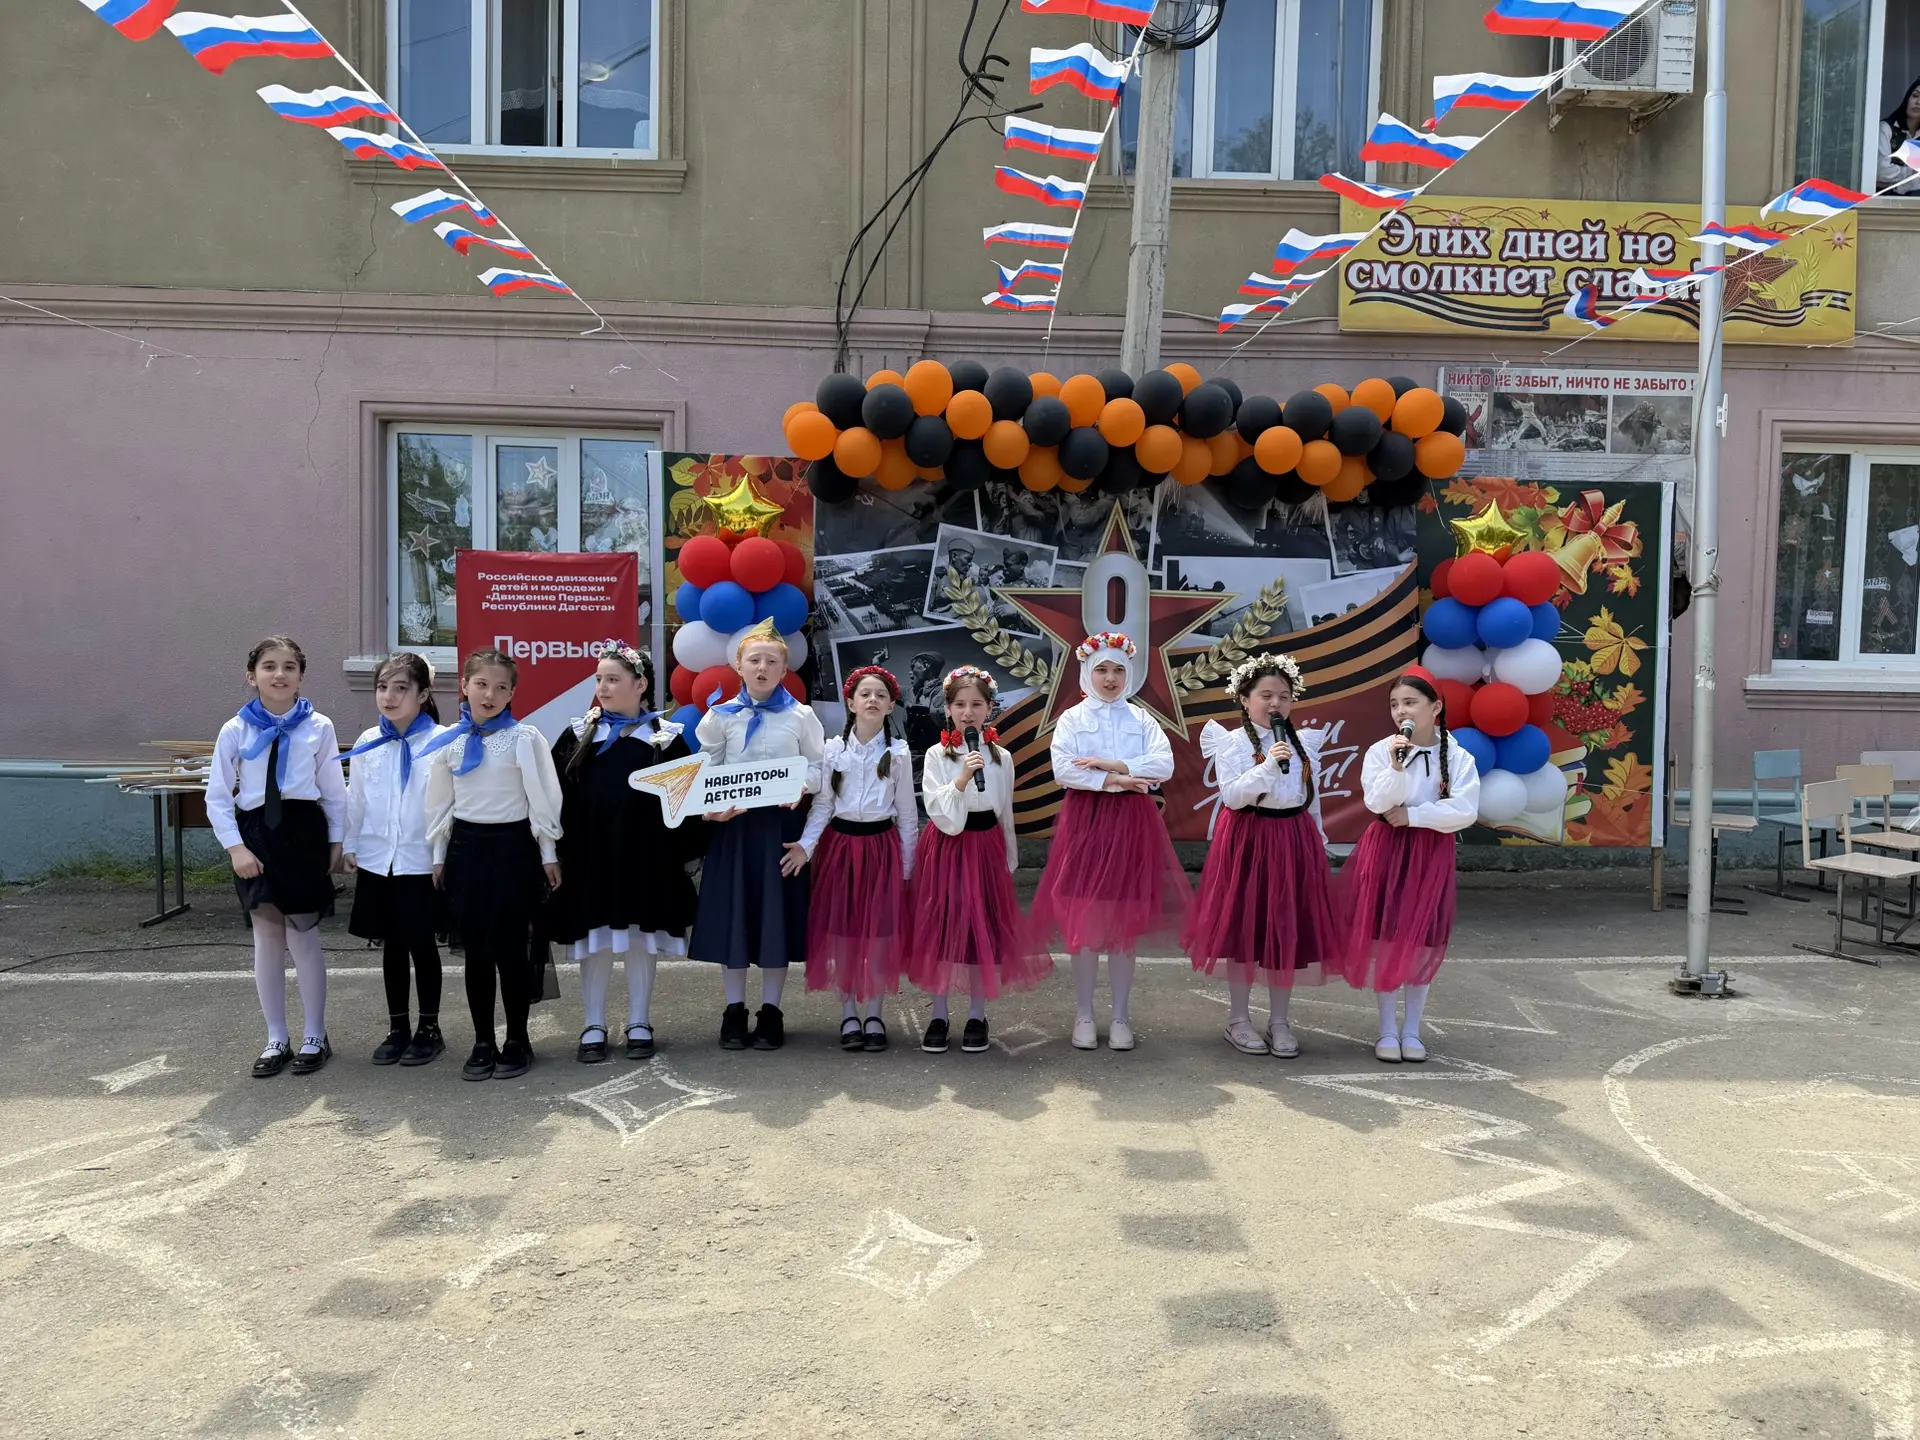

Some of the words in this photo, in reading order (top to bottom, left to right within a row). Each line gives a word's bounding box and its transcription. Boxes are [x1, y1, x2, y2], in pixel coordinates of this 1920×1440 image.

[1378, 211, 1491, 259] Этих
[1500, 218, 1611, 262] дней
[1620, 229, 1676, 264] не
[1346, 259, 1555, 296] смолкнет
[1448, 373, 1491, 387] НИКТО
[1494, 374, 1512, 387] НЕ
[1515, 375, 1563, 390] ЗАБЫТ,
[1566, 376, 1610, 390] НИЧТО
[1613, 377, 1631, 390] НЕ
[477, 572, 553, 583] Российское
[555, 574, 618, 583] движение
[491, 583, 528, 592] детей
[530, 584, 539, 592] и
[540, 584, 605, 592] молодежи
[485, 592, 556, 602] «Движение
[558, 593, 611, 603] Первых»
[481, 602, 557, 612] Республики
[558, 602, 616, 612] Дагестан
[704, 768, 789, 788] НАВИГАТОРЫ
[704, 786, 762, 805] ДЕТСТВА
